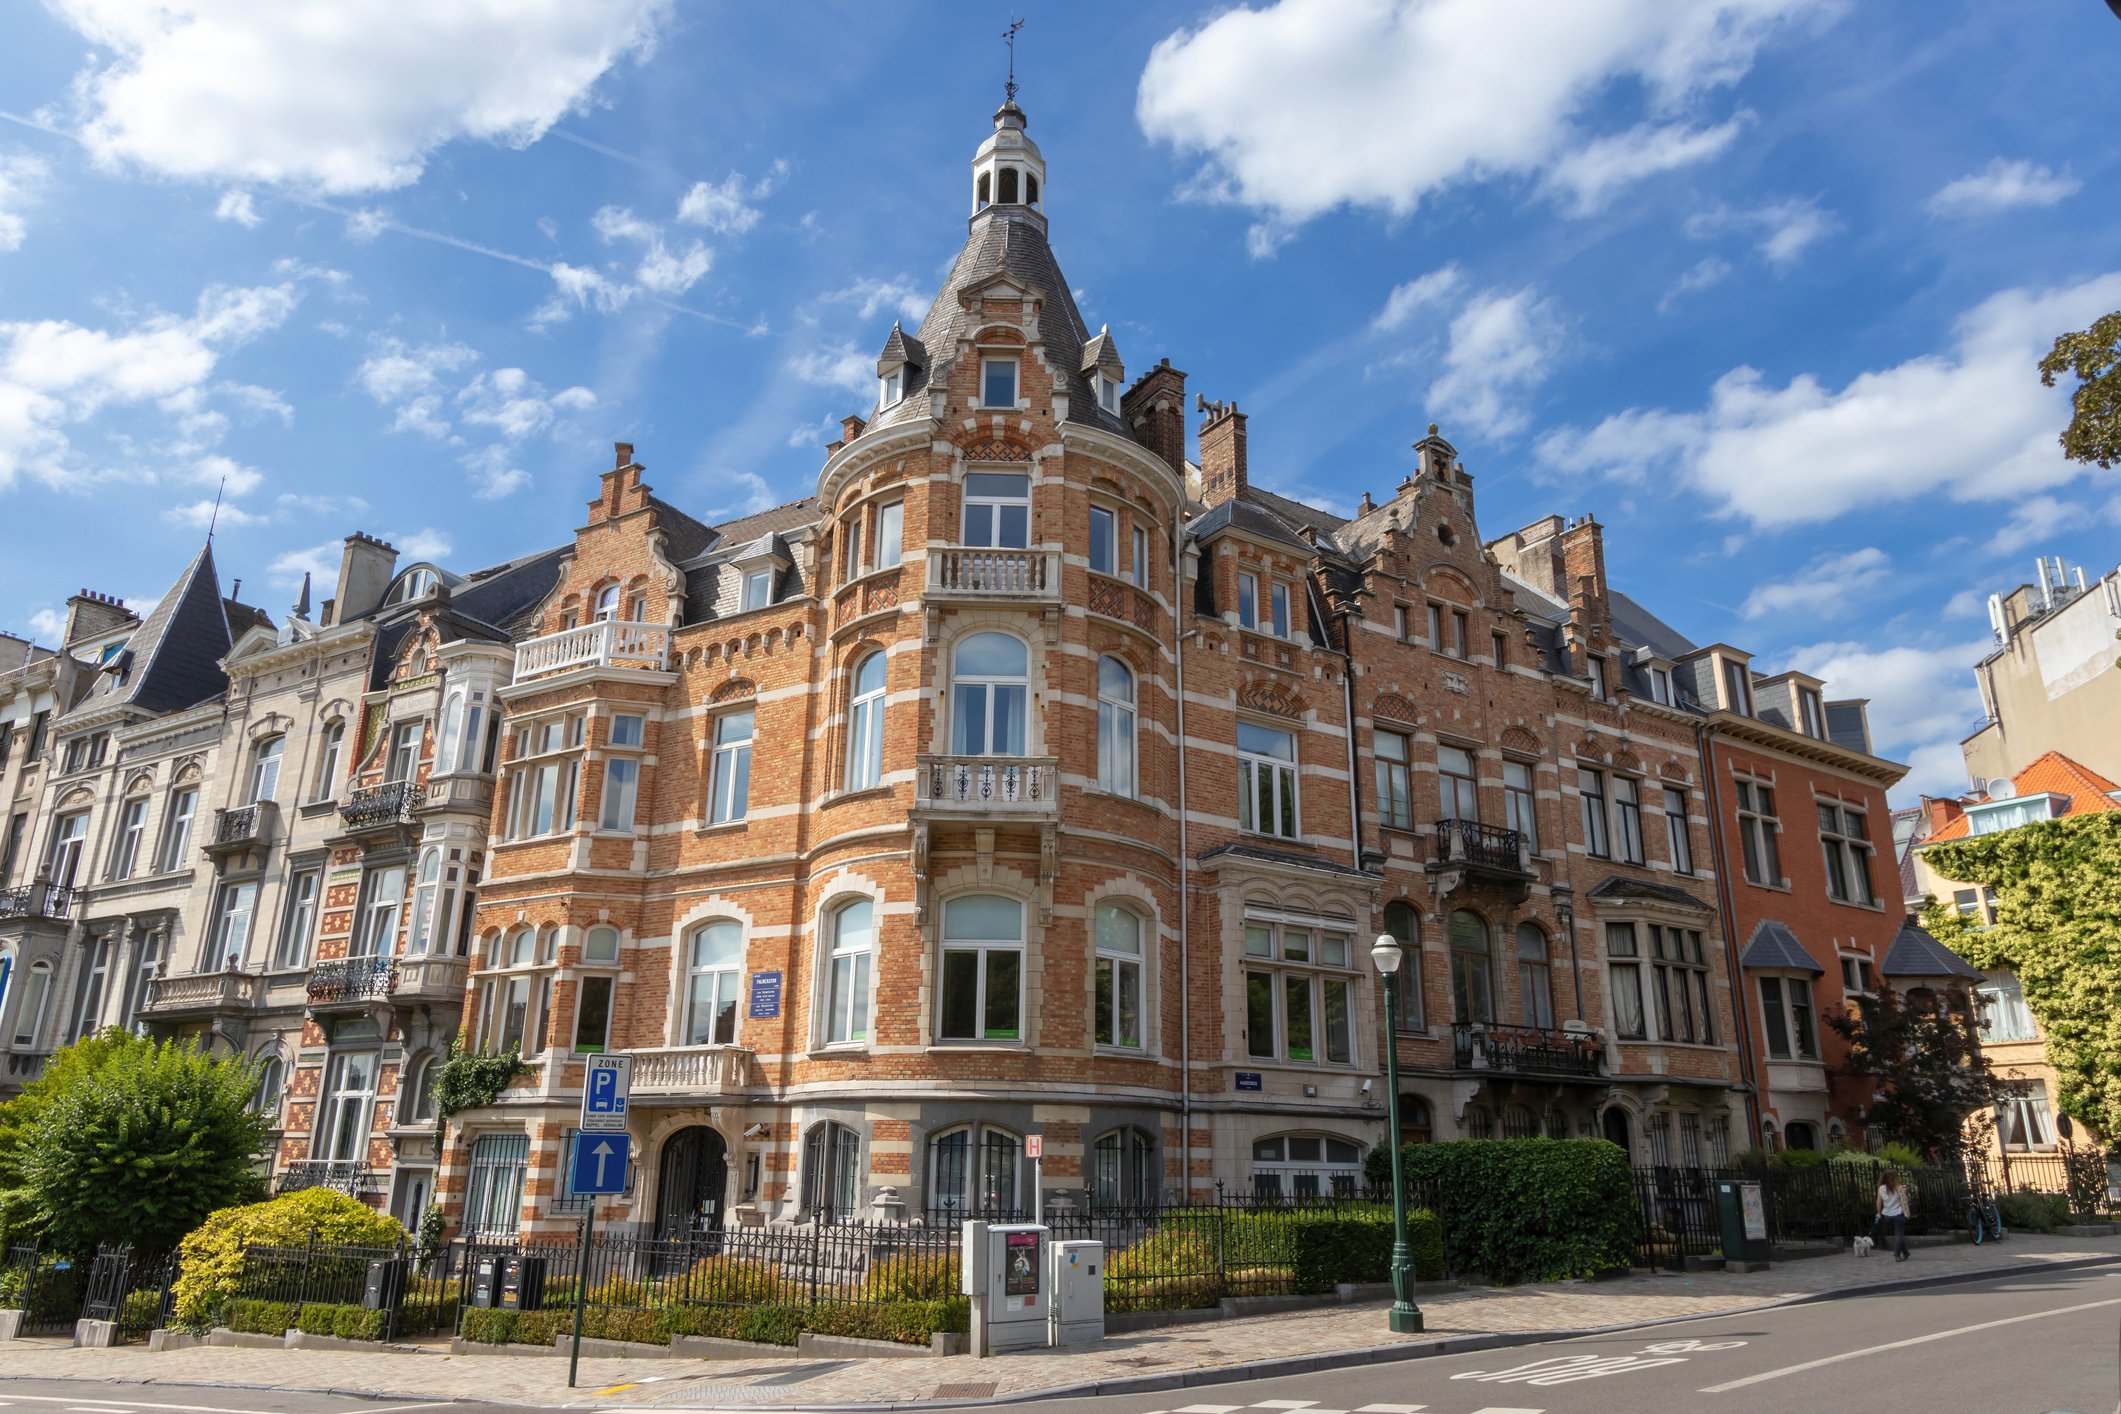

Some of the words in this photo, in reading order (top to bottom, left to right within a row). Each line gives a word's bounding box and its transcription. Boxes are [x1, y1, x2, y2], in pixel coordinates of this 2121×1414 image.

[598, 1059, 624, 1068] ZONE
[595, 1072, 611, 1095] P
[1029, 1138, 1040, 1155] H
[1449, 1354, 1691, 1386] BUS
